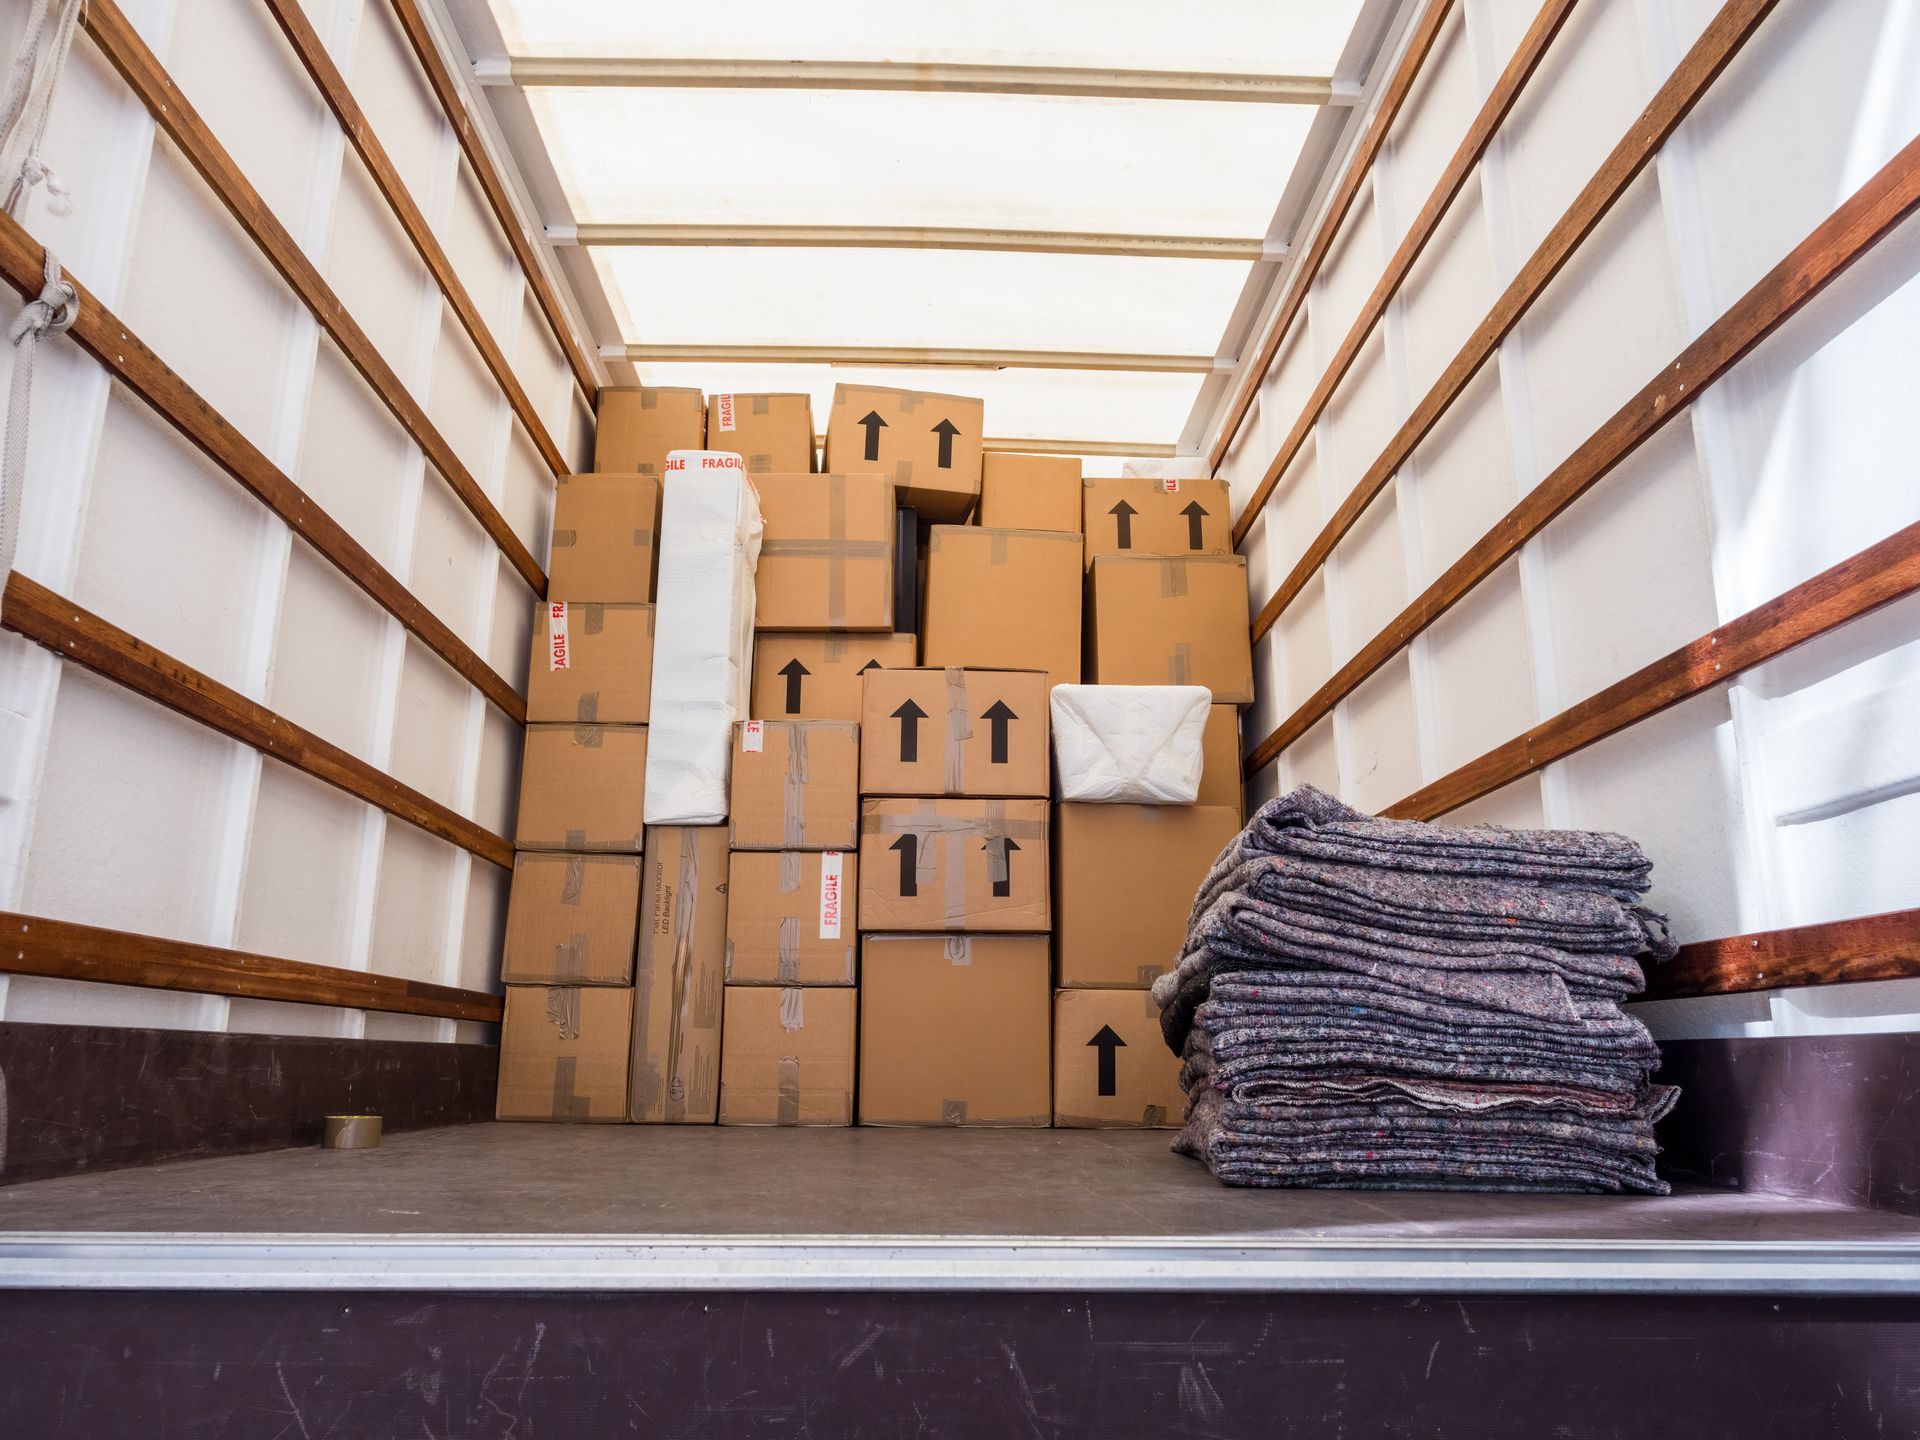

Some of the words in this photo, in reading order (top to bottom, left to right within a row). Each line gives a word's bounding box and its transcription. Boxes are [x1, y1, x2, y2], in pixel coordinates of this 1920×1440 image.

[662, 885, 673, 918] Backlight
[823, 875, 838, 926] FRAGILE
[662, 919, 670, 935] LED
